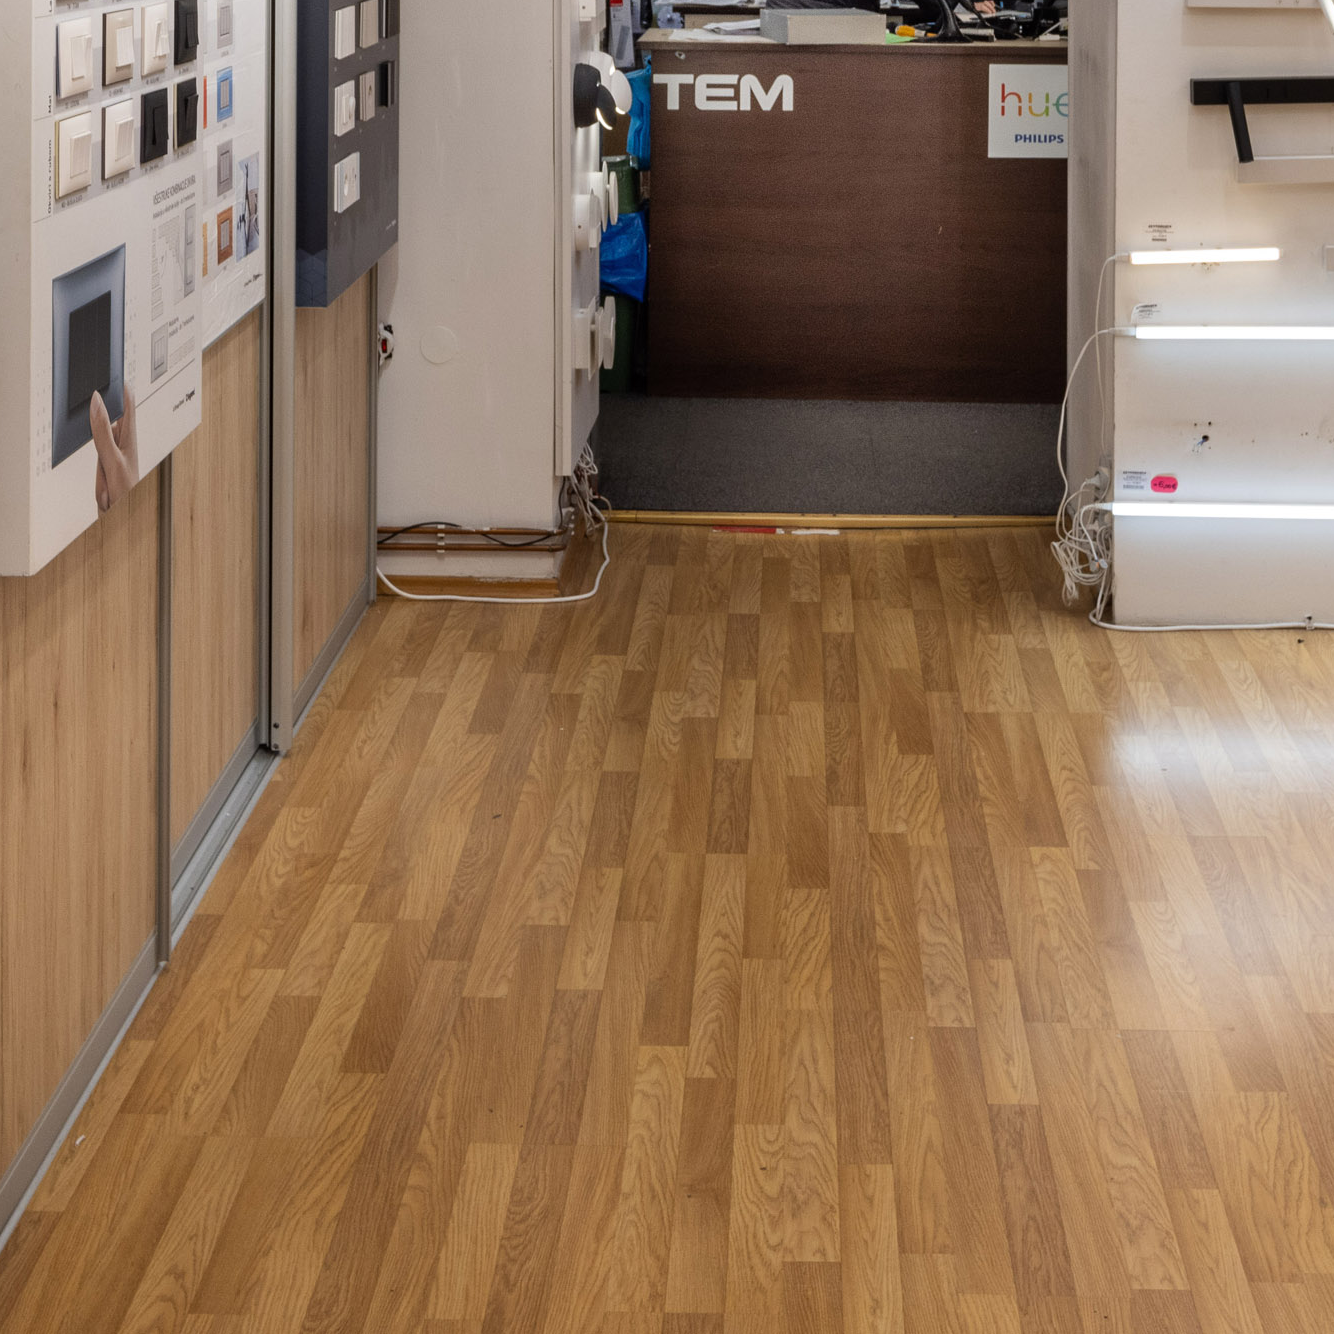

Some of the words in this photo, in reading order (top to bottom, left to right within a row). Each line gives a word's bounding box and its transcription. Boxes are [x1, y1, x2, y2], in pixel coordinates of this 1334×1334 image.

[653, 74, 794, 111] TEM
[1002, 83, 1068, 117] hue
[1014, 134, 1064, 144] PHILIPS
